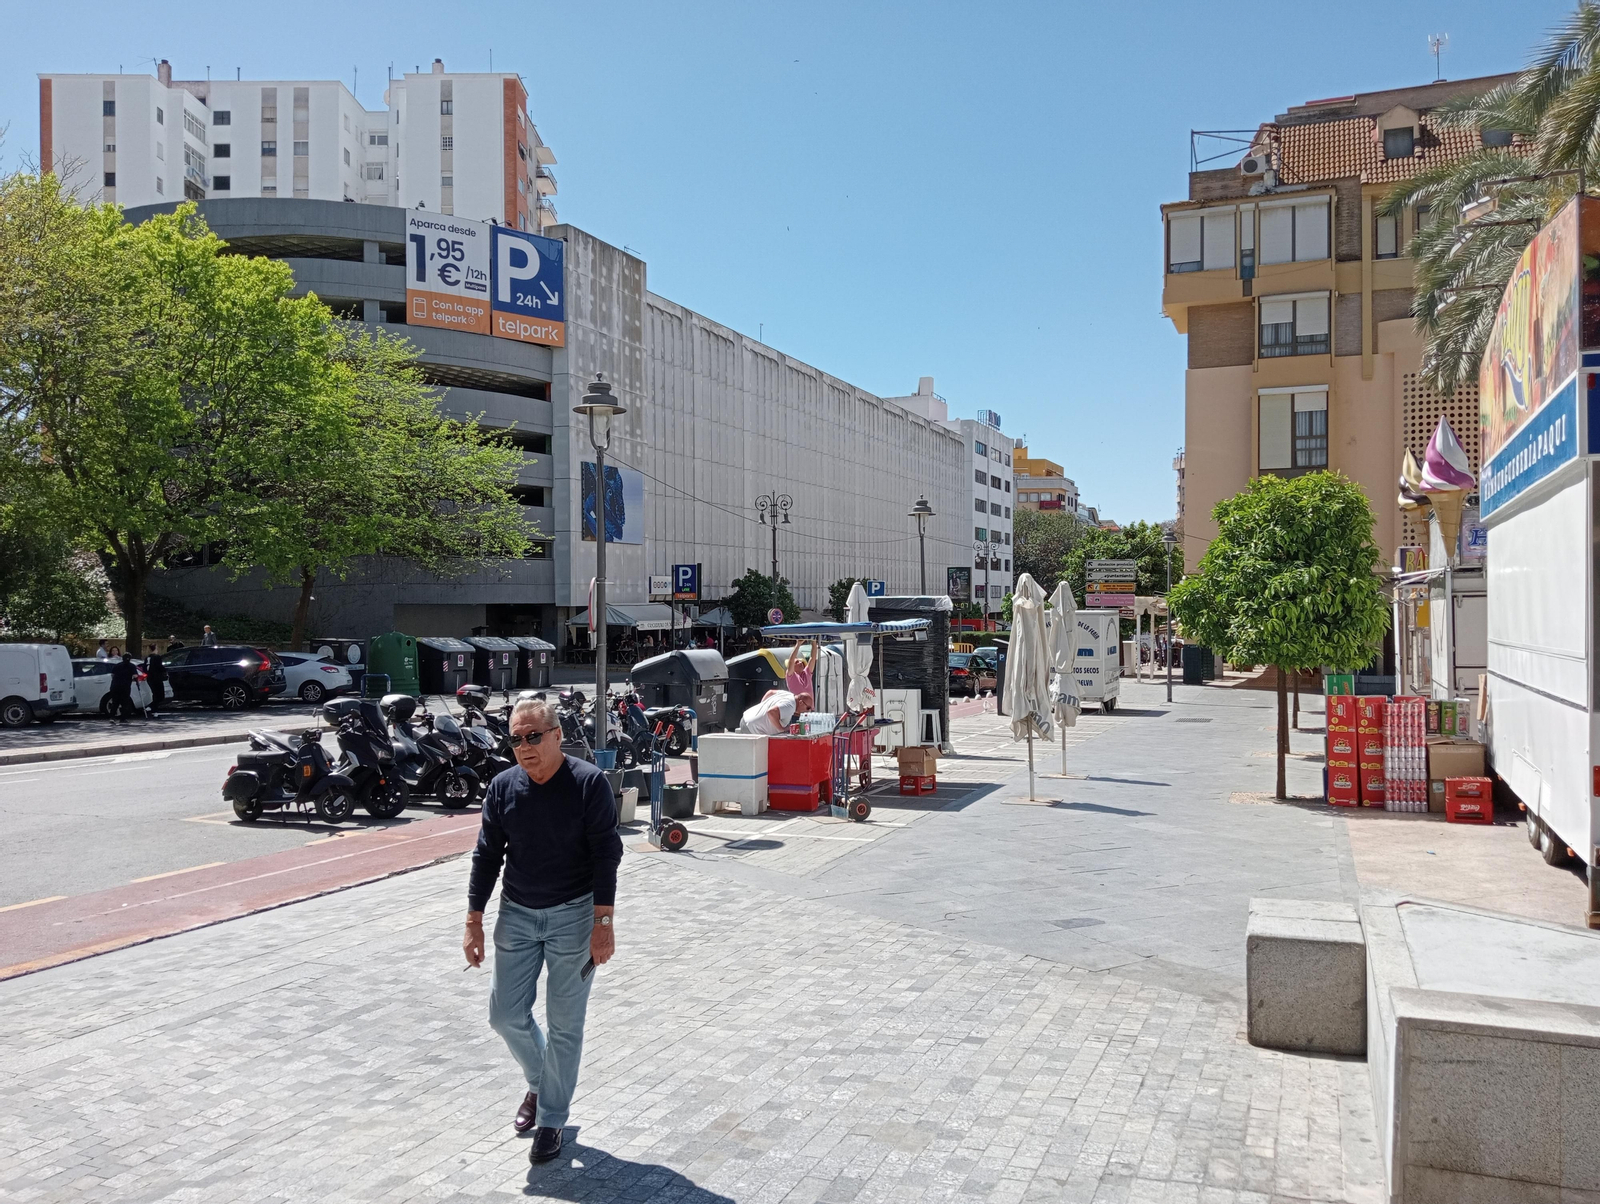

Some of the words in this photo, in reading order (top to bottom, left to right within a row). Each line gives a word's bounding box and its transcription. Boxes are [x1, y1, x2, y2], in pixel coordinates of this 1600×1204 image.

[409, 218, 446, 231] Aparca
[448, 224, 476, 237] desde
[409, 233, 465, 283] 1,95
[497, 233, 541, 303] P
[437, 262, 461, 287] €
[465, 265, 487, 281] /12h
[432, 299, 452, 310] Con
[454, 302, 464, 312] la
[465, 306, 484, 317] app
[516, 292, 541, 309] 24h
[432, 311, 467, 325] telpark
[498, 316, 559, 341] telpark
[678, 566, 692, 587] P
[871, 582, 881, 594] P
